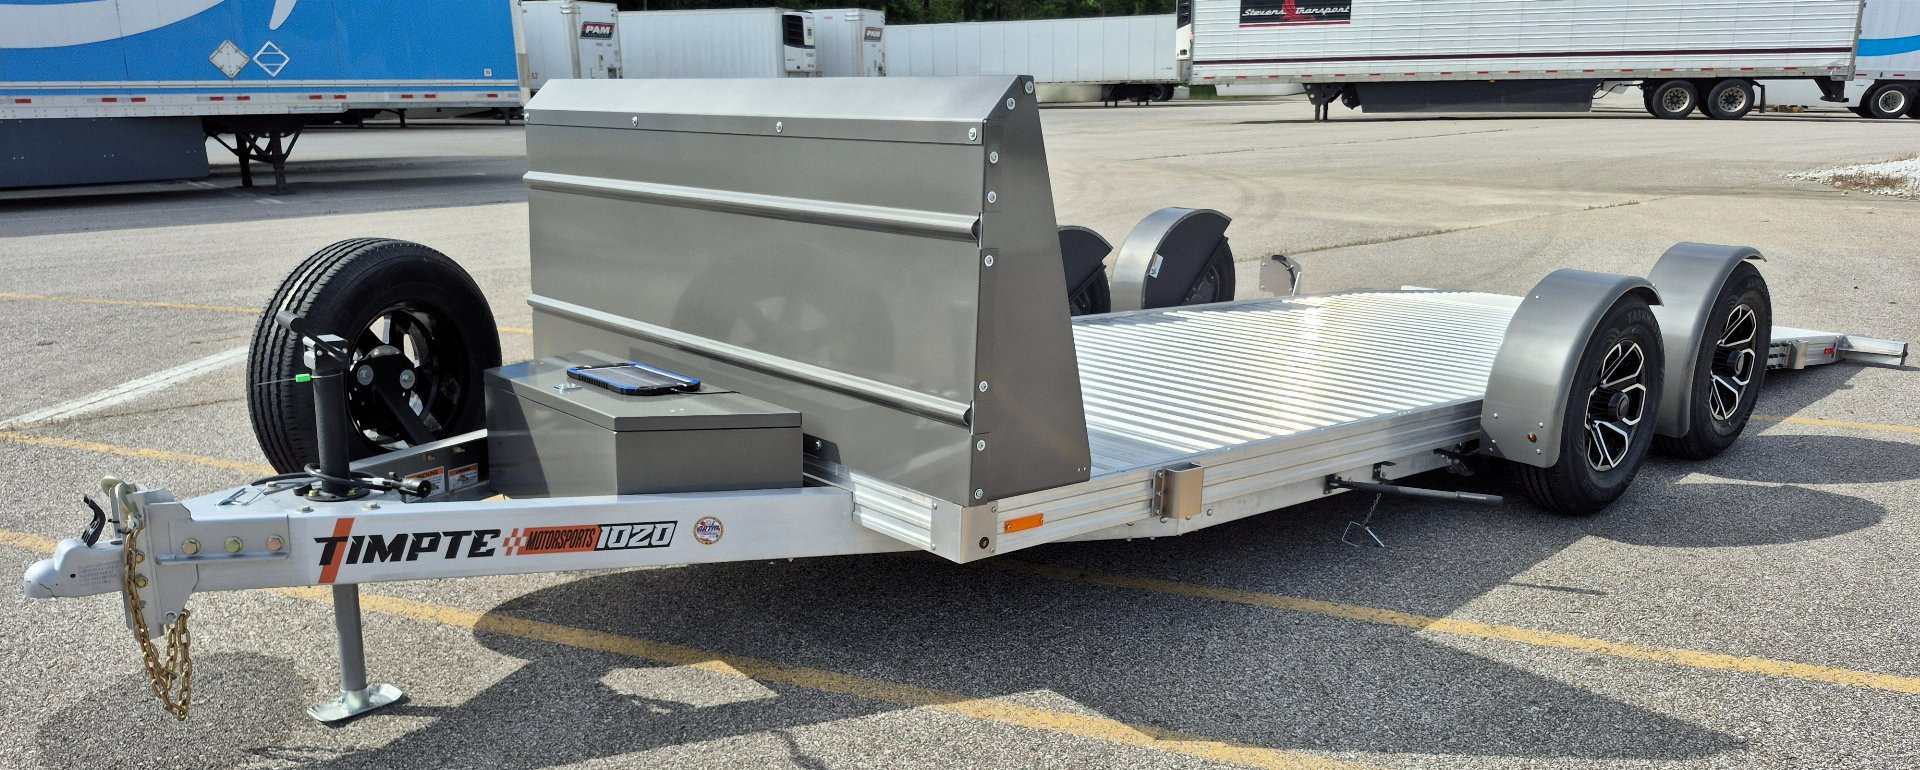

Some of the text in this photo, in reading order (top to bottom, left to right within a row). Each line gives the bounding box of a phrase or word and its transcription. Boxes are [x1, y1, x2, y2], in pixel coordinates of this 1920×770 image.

[1242, 6, 1350, 16] Stevens Transport
[585, 25, 610, 34] PAM
[313, 517, 676, 584] TIMPTE MOTORSPORTS 1020
